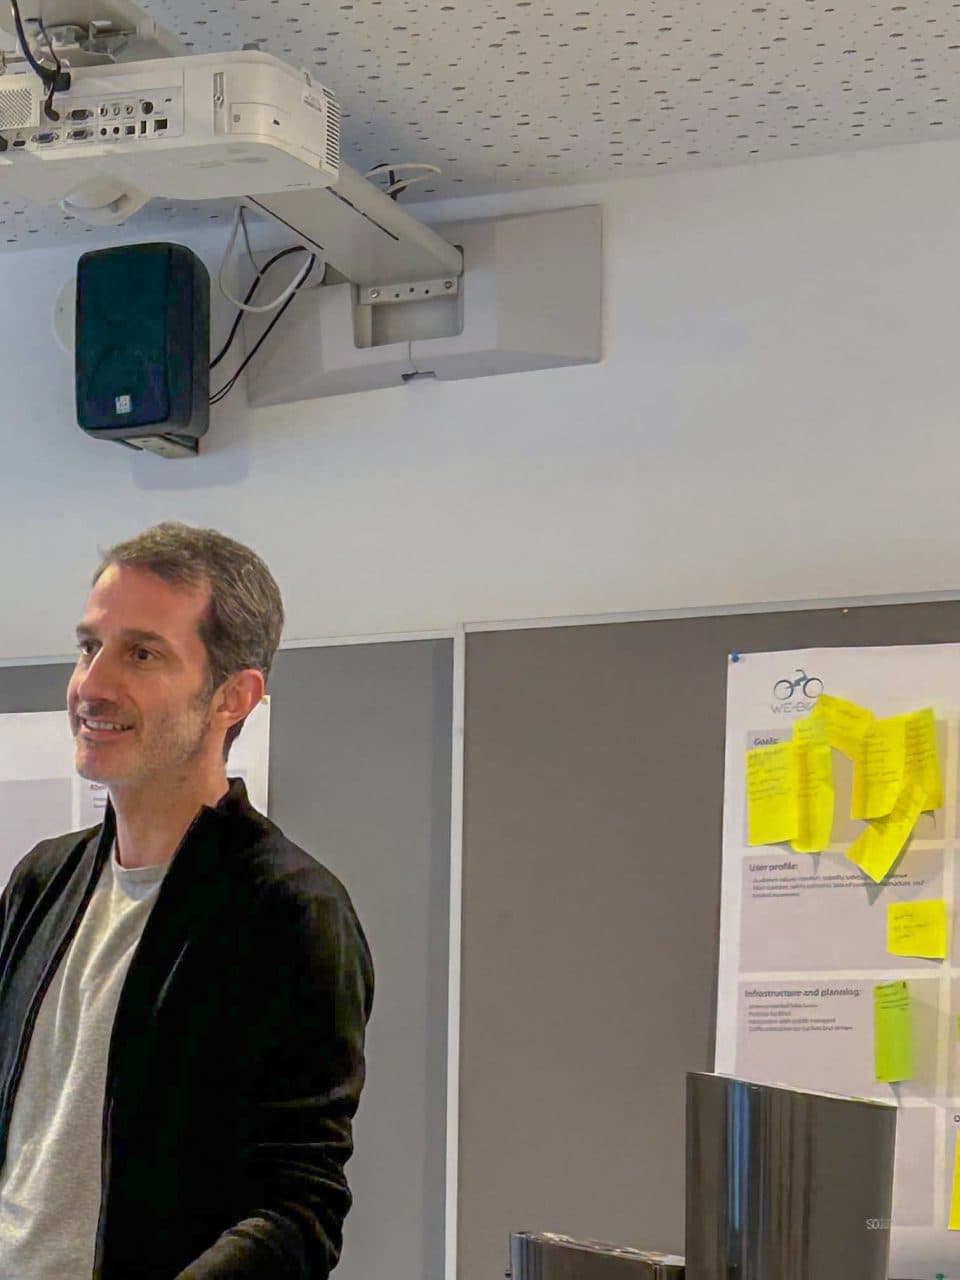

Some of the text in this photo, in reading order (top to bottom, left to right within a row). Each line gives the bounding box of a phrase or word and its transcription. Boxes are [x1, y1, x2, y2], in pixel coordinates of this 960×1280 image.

[745, 988, 862, 999] Infrastructure and planning:
